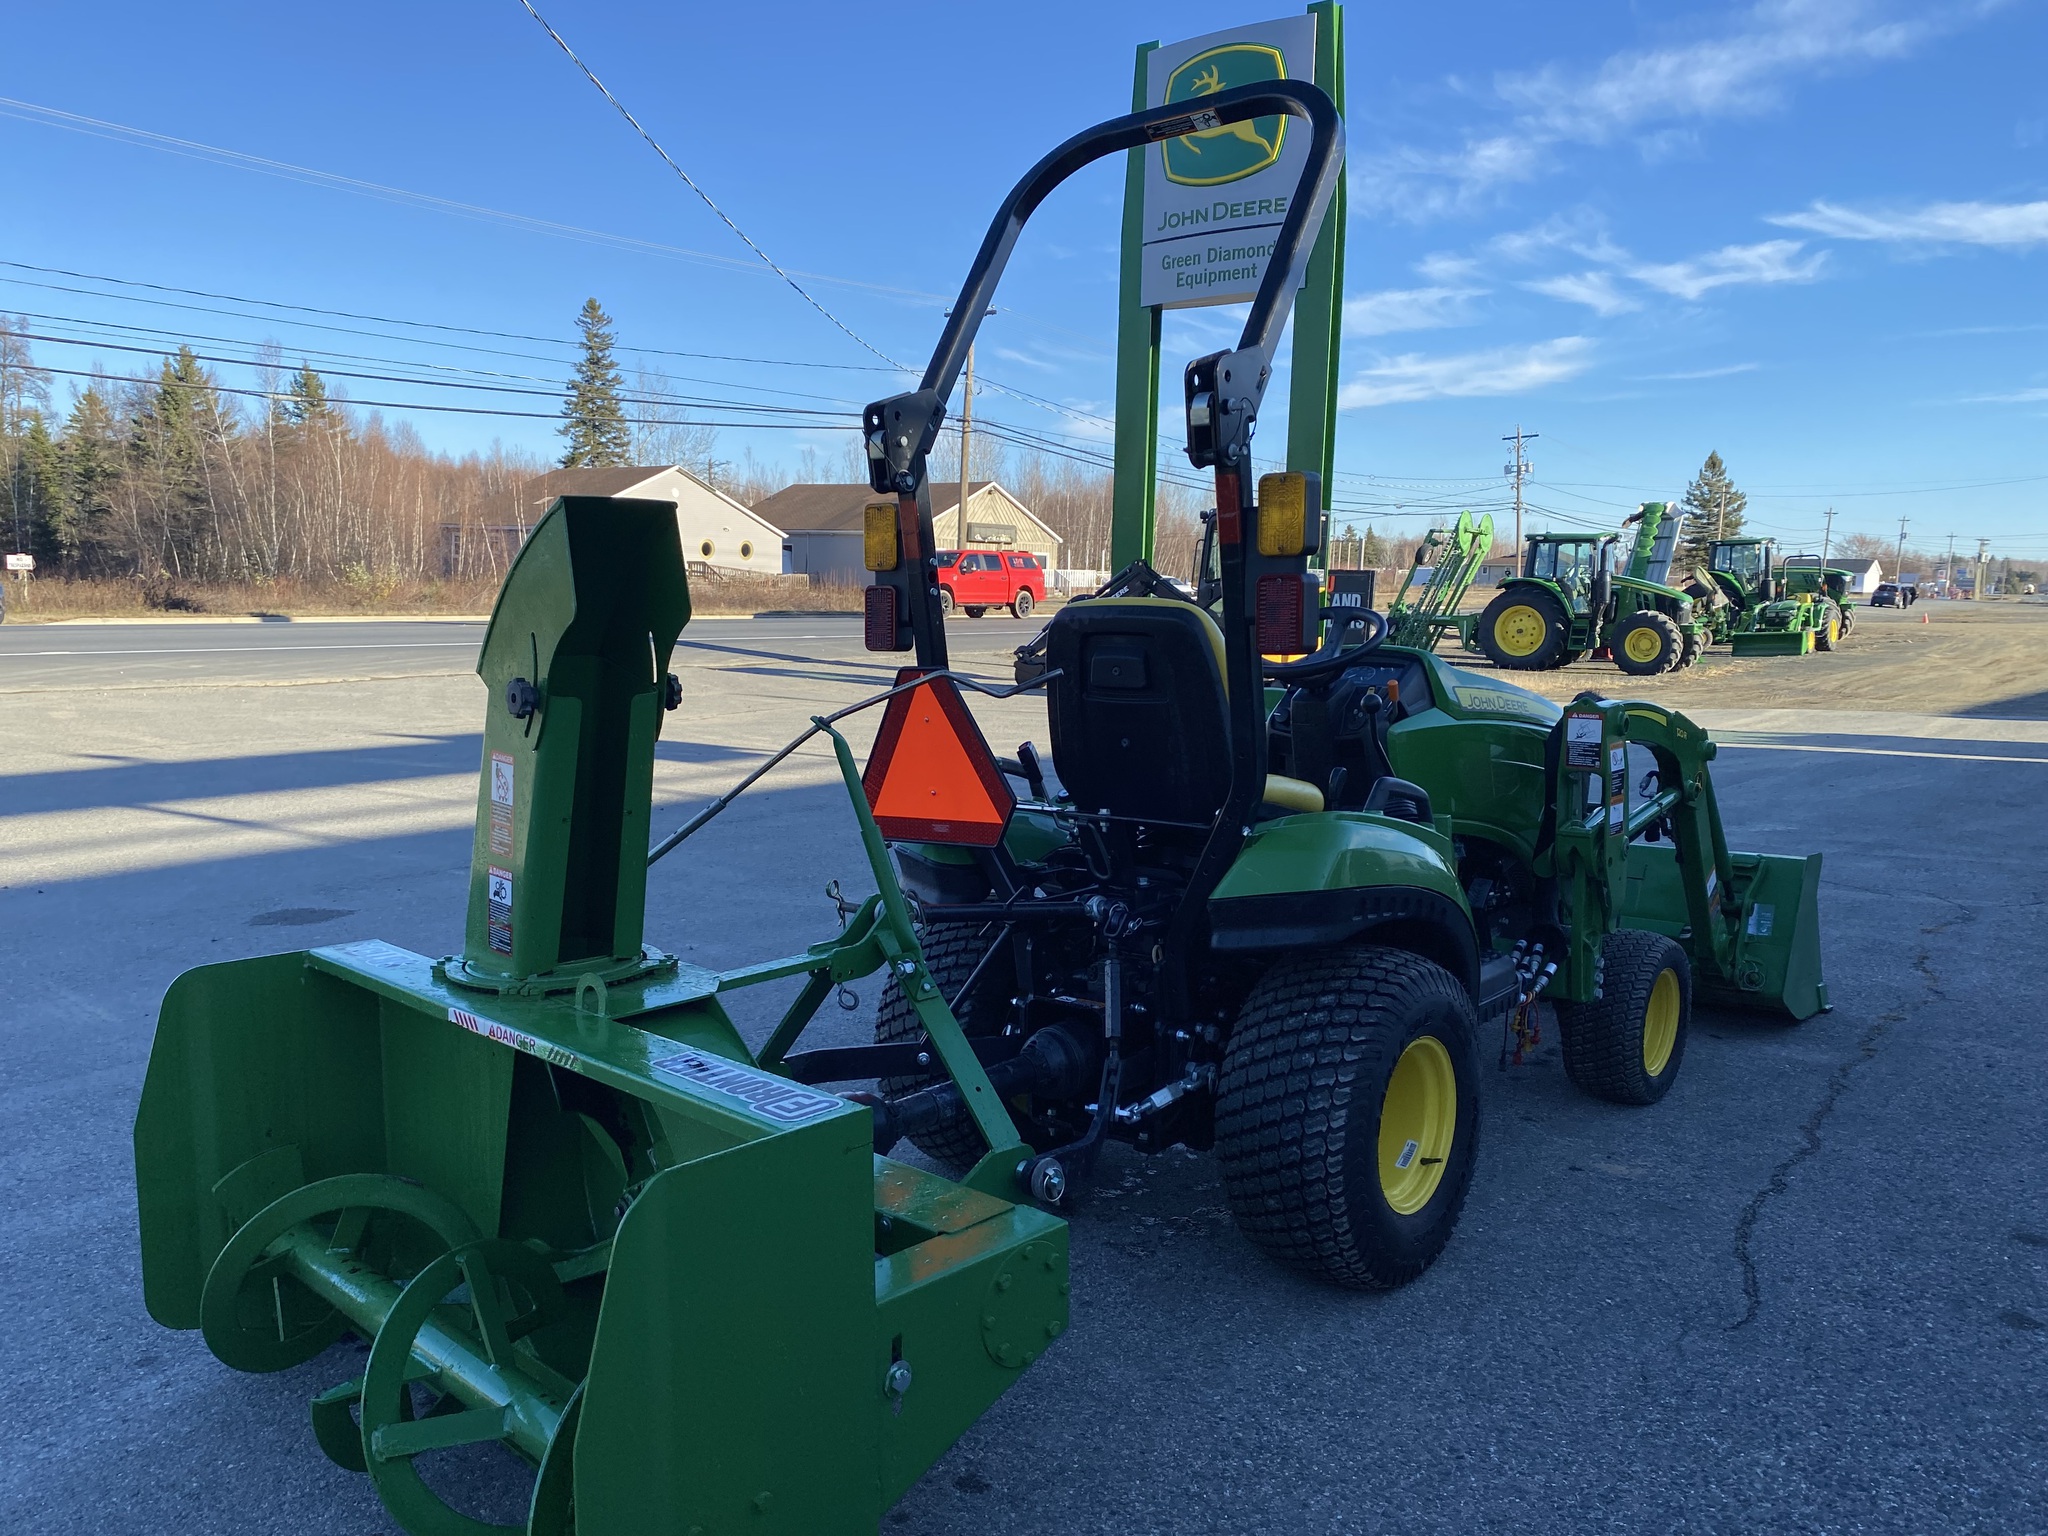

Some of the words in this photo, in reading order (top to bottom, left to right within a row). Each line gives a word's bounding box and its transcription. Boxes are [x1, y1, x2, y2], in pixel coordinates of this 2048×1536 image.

[1157, 208, 1209, 231] JOHN
[1212, 197, 1287, 223] DEERE
[1161, 252, 1201, 270] Green
[1176, 262, 1258, 289] Equipment
[1468, 693, 1496, 709] JOHN
[1497, 696, 1529, 712] DEERE
[495, 1025, 536, 1053] DANGER
